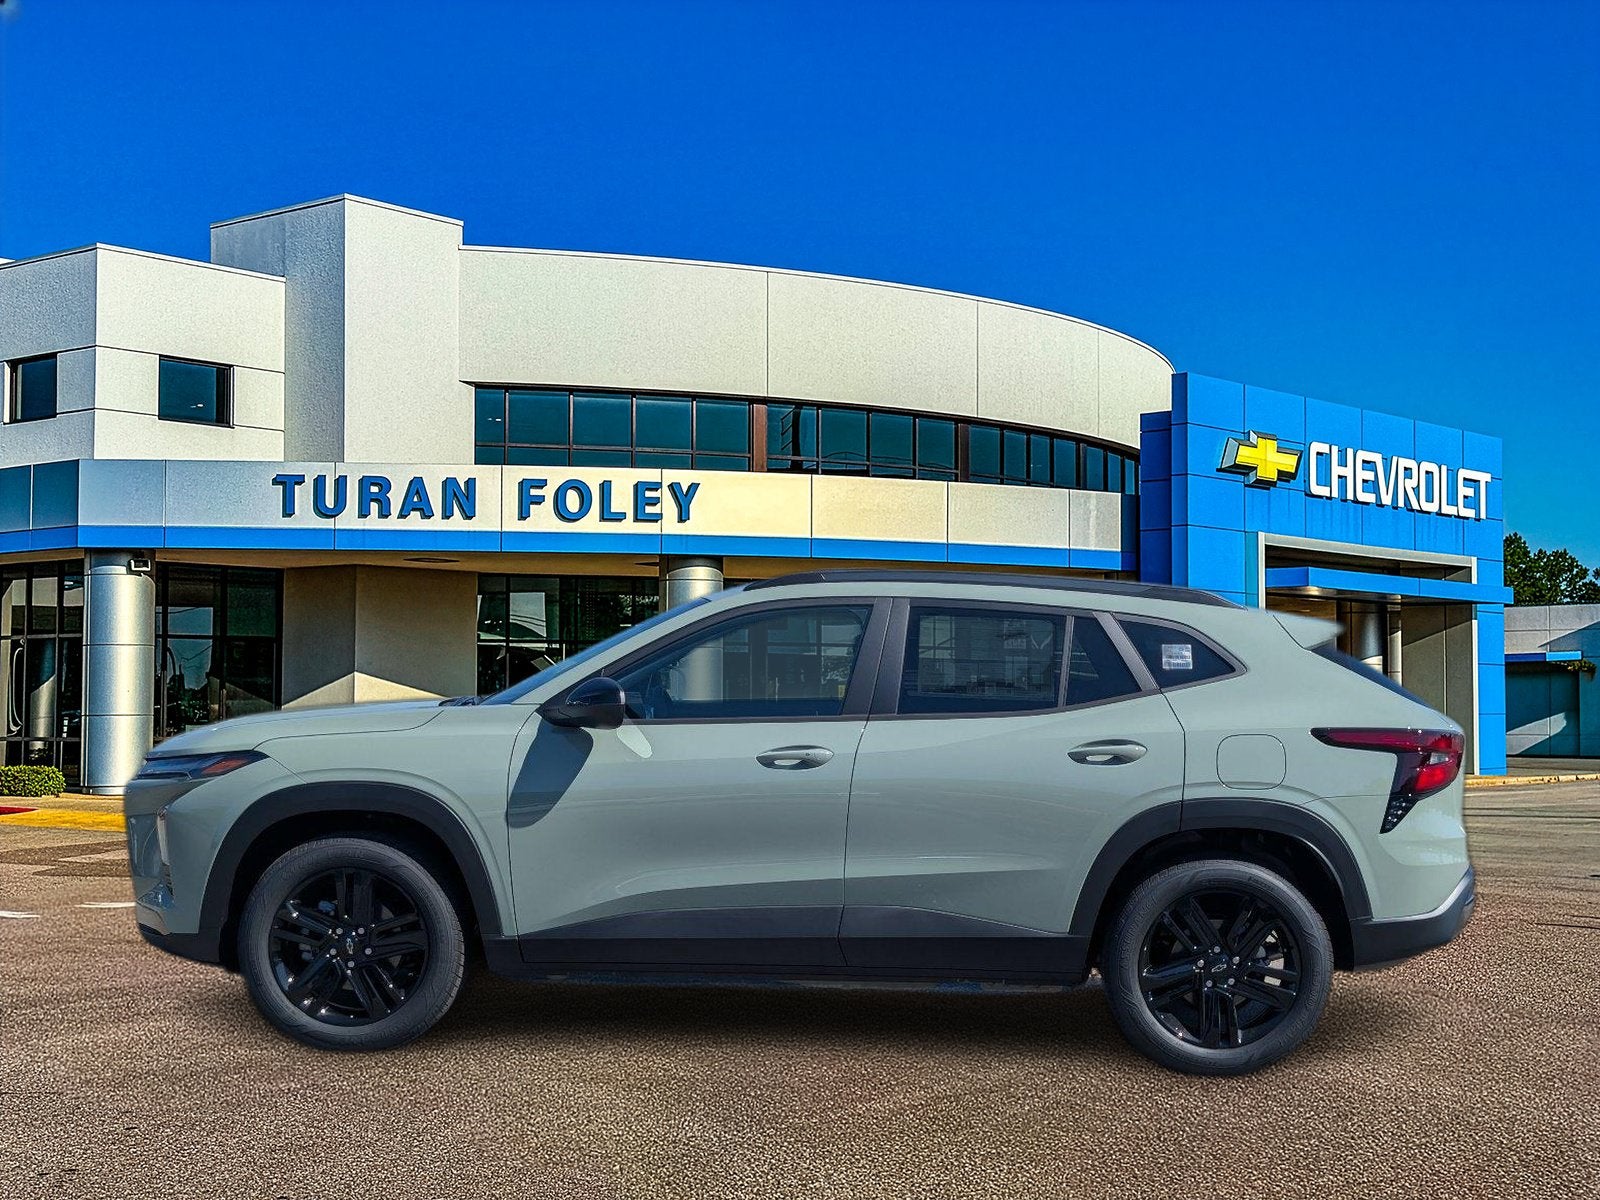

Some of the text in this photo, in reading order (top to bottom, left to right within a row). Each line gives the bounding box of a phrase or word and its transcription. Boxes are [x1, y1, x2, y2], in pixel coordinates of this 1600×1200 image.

[272, 473, 700, 523] TURAN FOLEY
[1308, 441, 1492, 520] CHEVROLET
